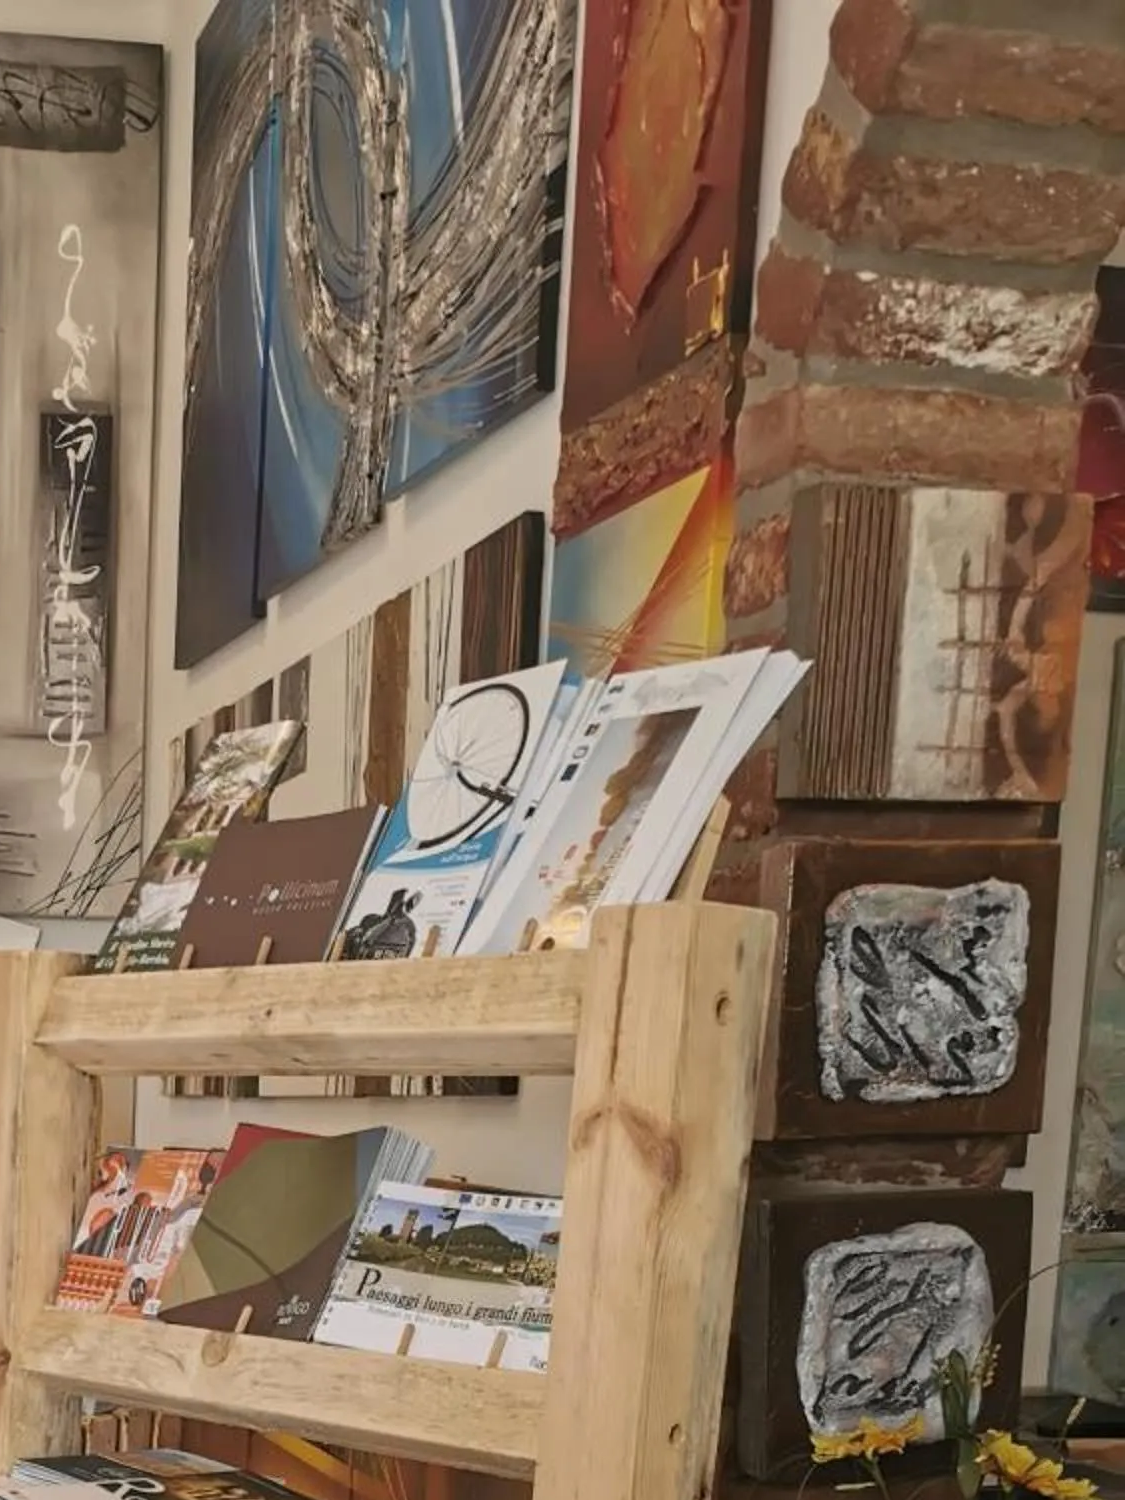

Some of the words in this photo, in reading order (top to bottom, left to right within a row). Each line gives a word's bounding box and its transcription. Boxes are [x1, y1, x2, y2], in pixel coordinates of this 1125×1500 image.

[355, 1266, 421, 1312] Paesaggi
[424, 1295, 465, 1318] lungo
[474, 1303, 520, 1325] grandi
